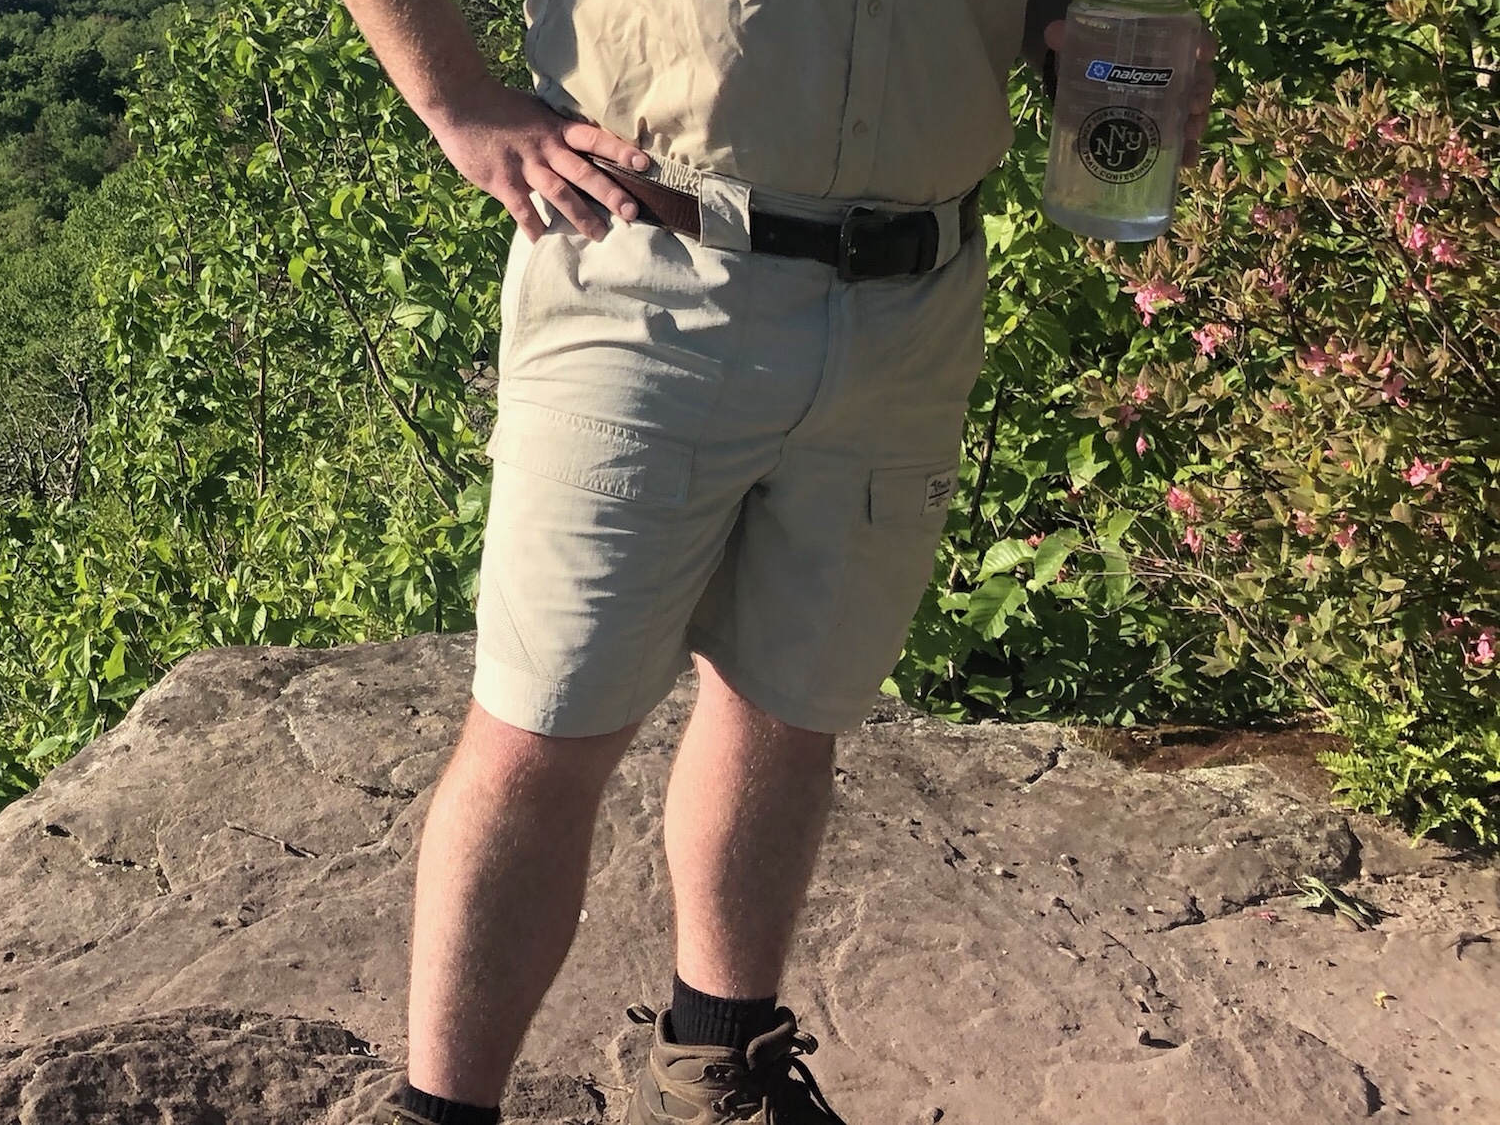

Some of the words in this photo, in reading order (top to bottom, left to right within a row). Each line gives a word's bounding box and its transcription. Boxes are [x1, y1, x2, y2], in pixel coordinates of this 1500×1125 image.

[1110, 69, 1168, 83] nalgene
[1091, 110, 1114, 123] YORK
[1124, 110, 1143, 122] NEW
[1083, 151, 1098, 172] TRAIL
[1100, 158, 1152, 180] CONFERENCE
